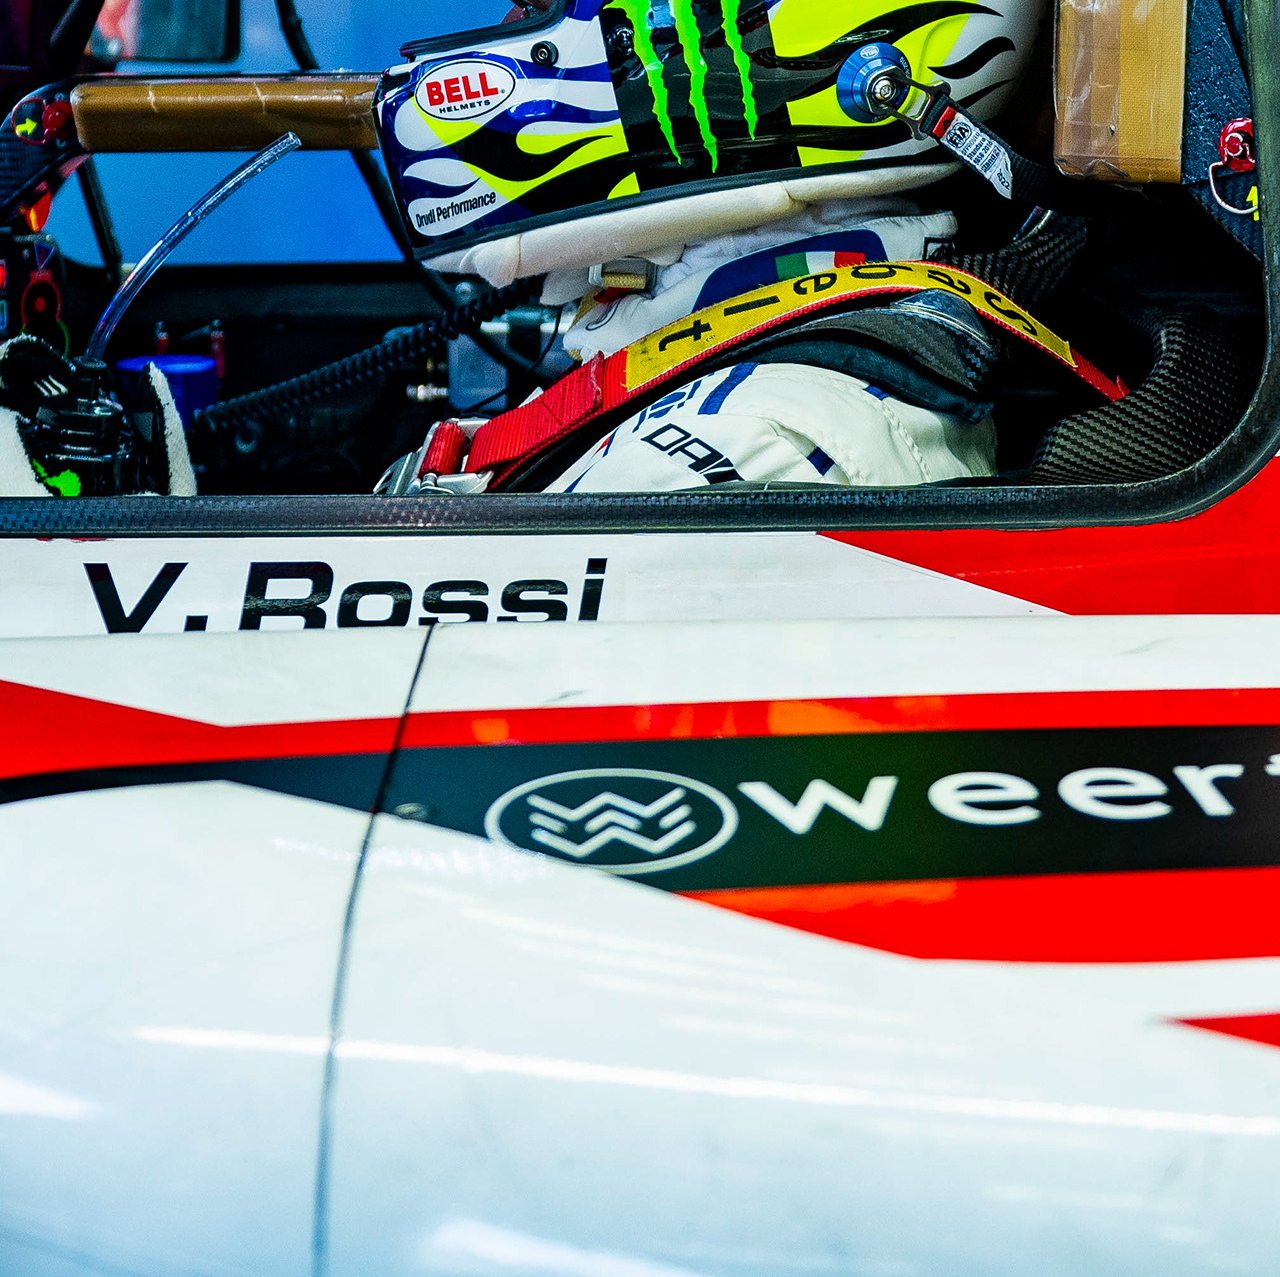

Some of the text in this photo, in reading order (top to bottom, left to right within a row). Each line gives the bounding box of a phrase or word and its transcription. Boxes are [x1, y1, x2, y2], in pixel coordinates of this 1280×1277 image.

[425, 72, 499, 107] BELL
[438, 98, 491, 115] HELMETS
[948, 125, 970, 148] FIA
[437, 190, 497, 220] Performance
[237, 557, 609, 631] Rossi
